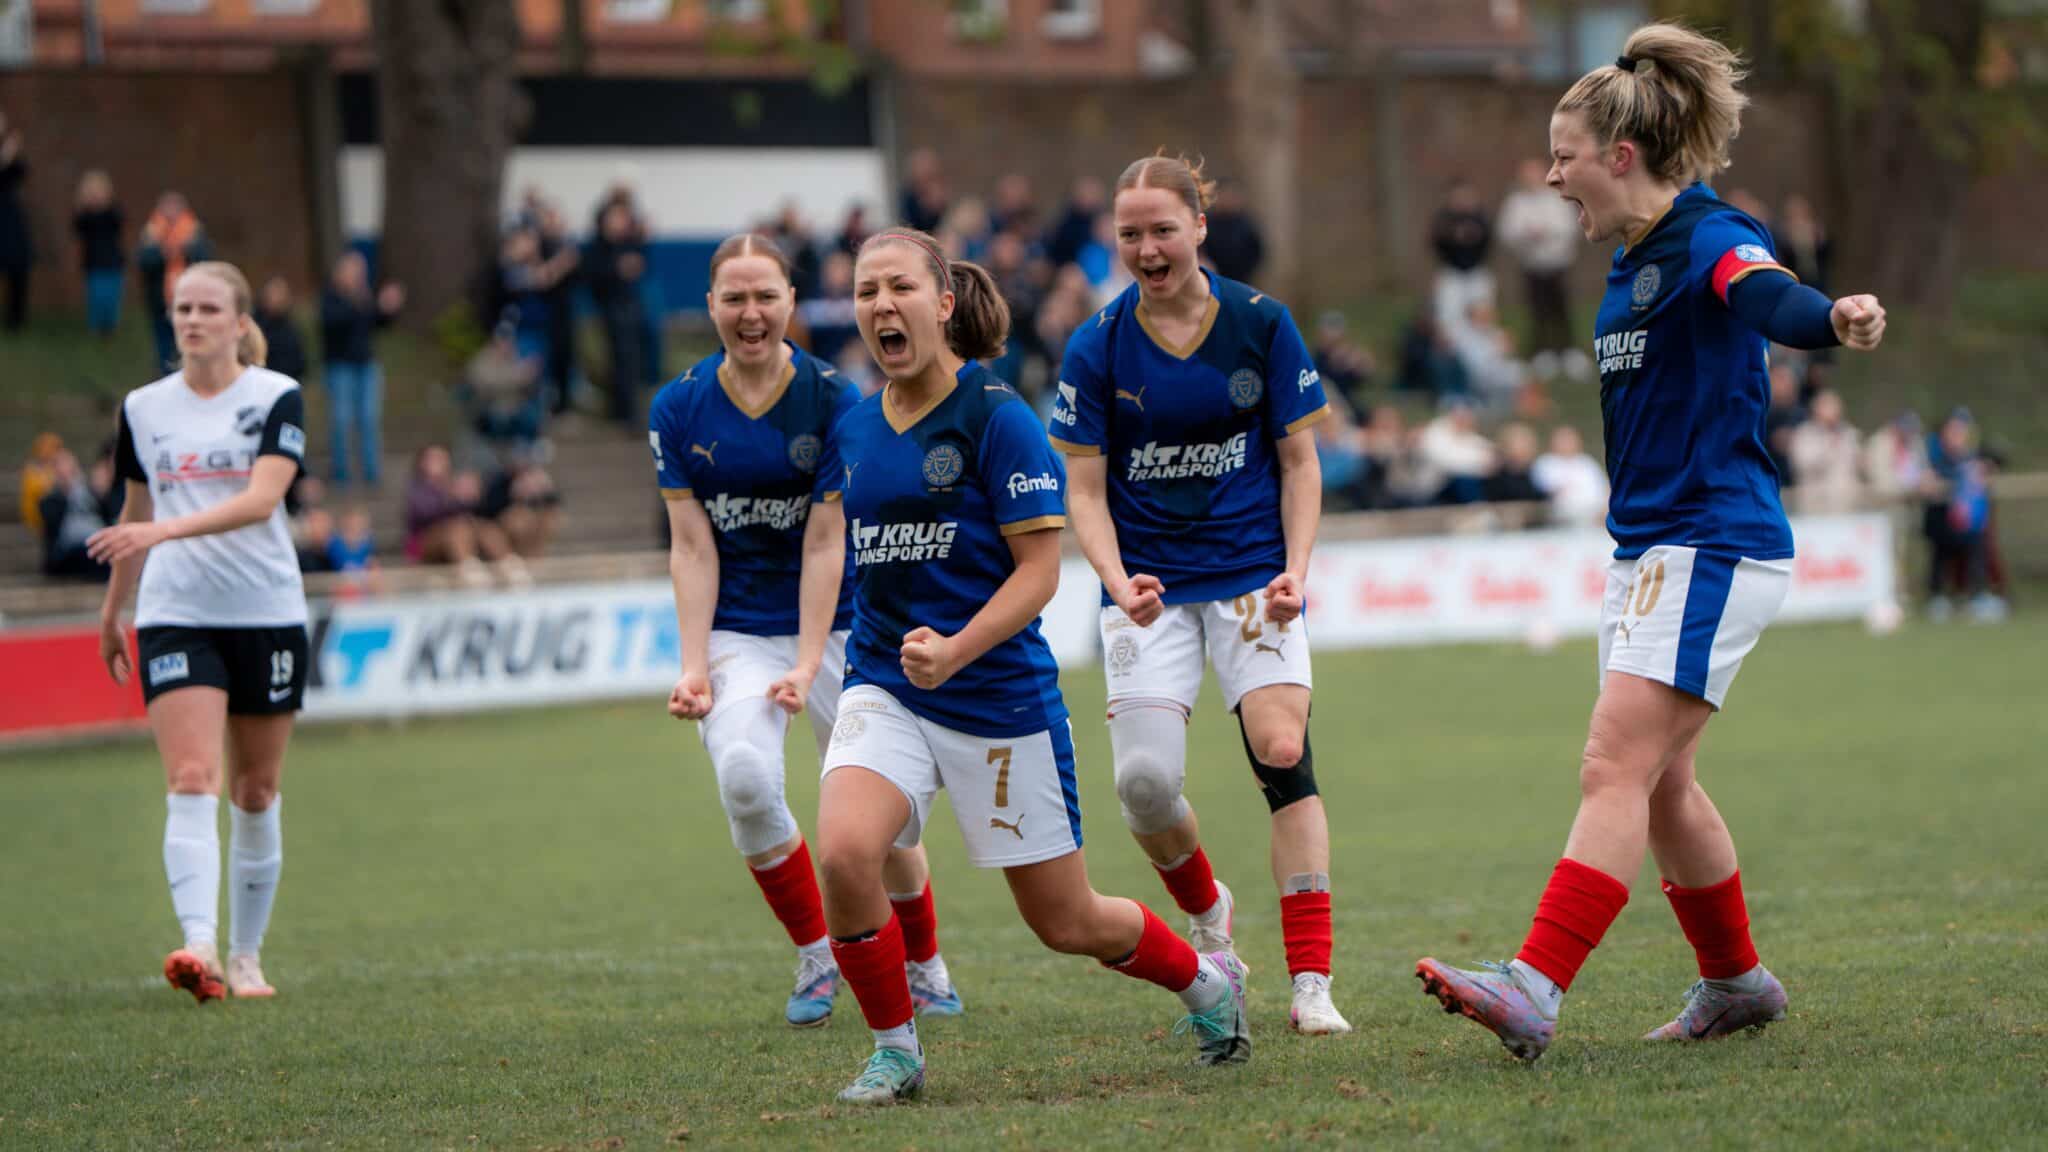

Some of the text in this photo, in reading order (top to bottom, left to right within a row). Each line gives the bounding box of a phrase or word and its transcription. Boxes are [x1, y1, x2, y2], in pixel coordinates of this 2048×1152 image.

[1602, 330, 1649, 358] KRUG
[1181, 431, 1247, 464] KRUG
[1127, 453, 1245, 481] TRANSPORTE
[1006, 472, 1059, 499] famila
[880, 522, 958, 547] KRUG
[1622, 560, 1665, 617] 10
[406, 607, 595, 685] KRUG
[270, 649, 294, 686] 19
[986, 746, 1013, 808] 7
